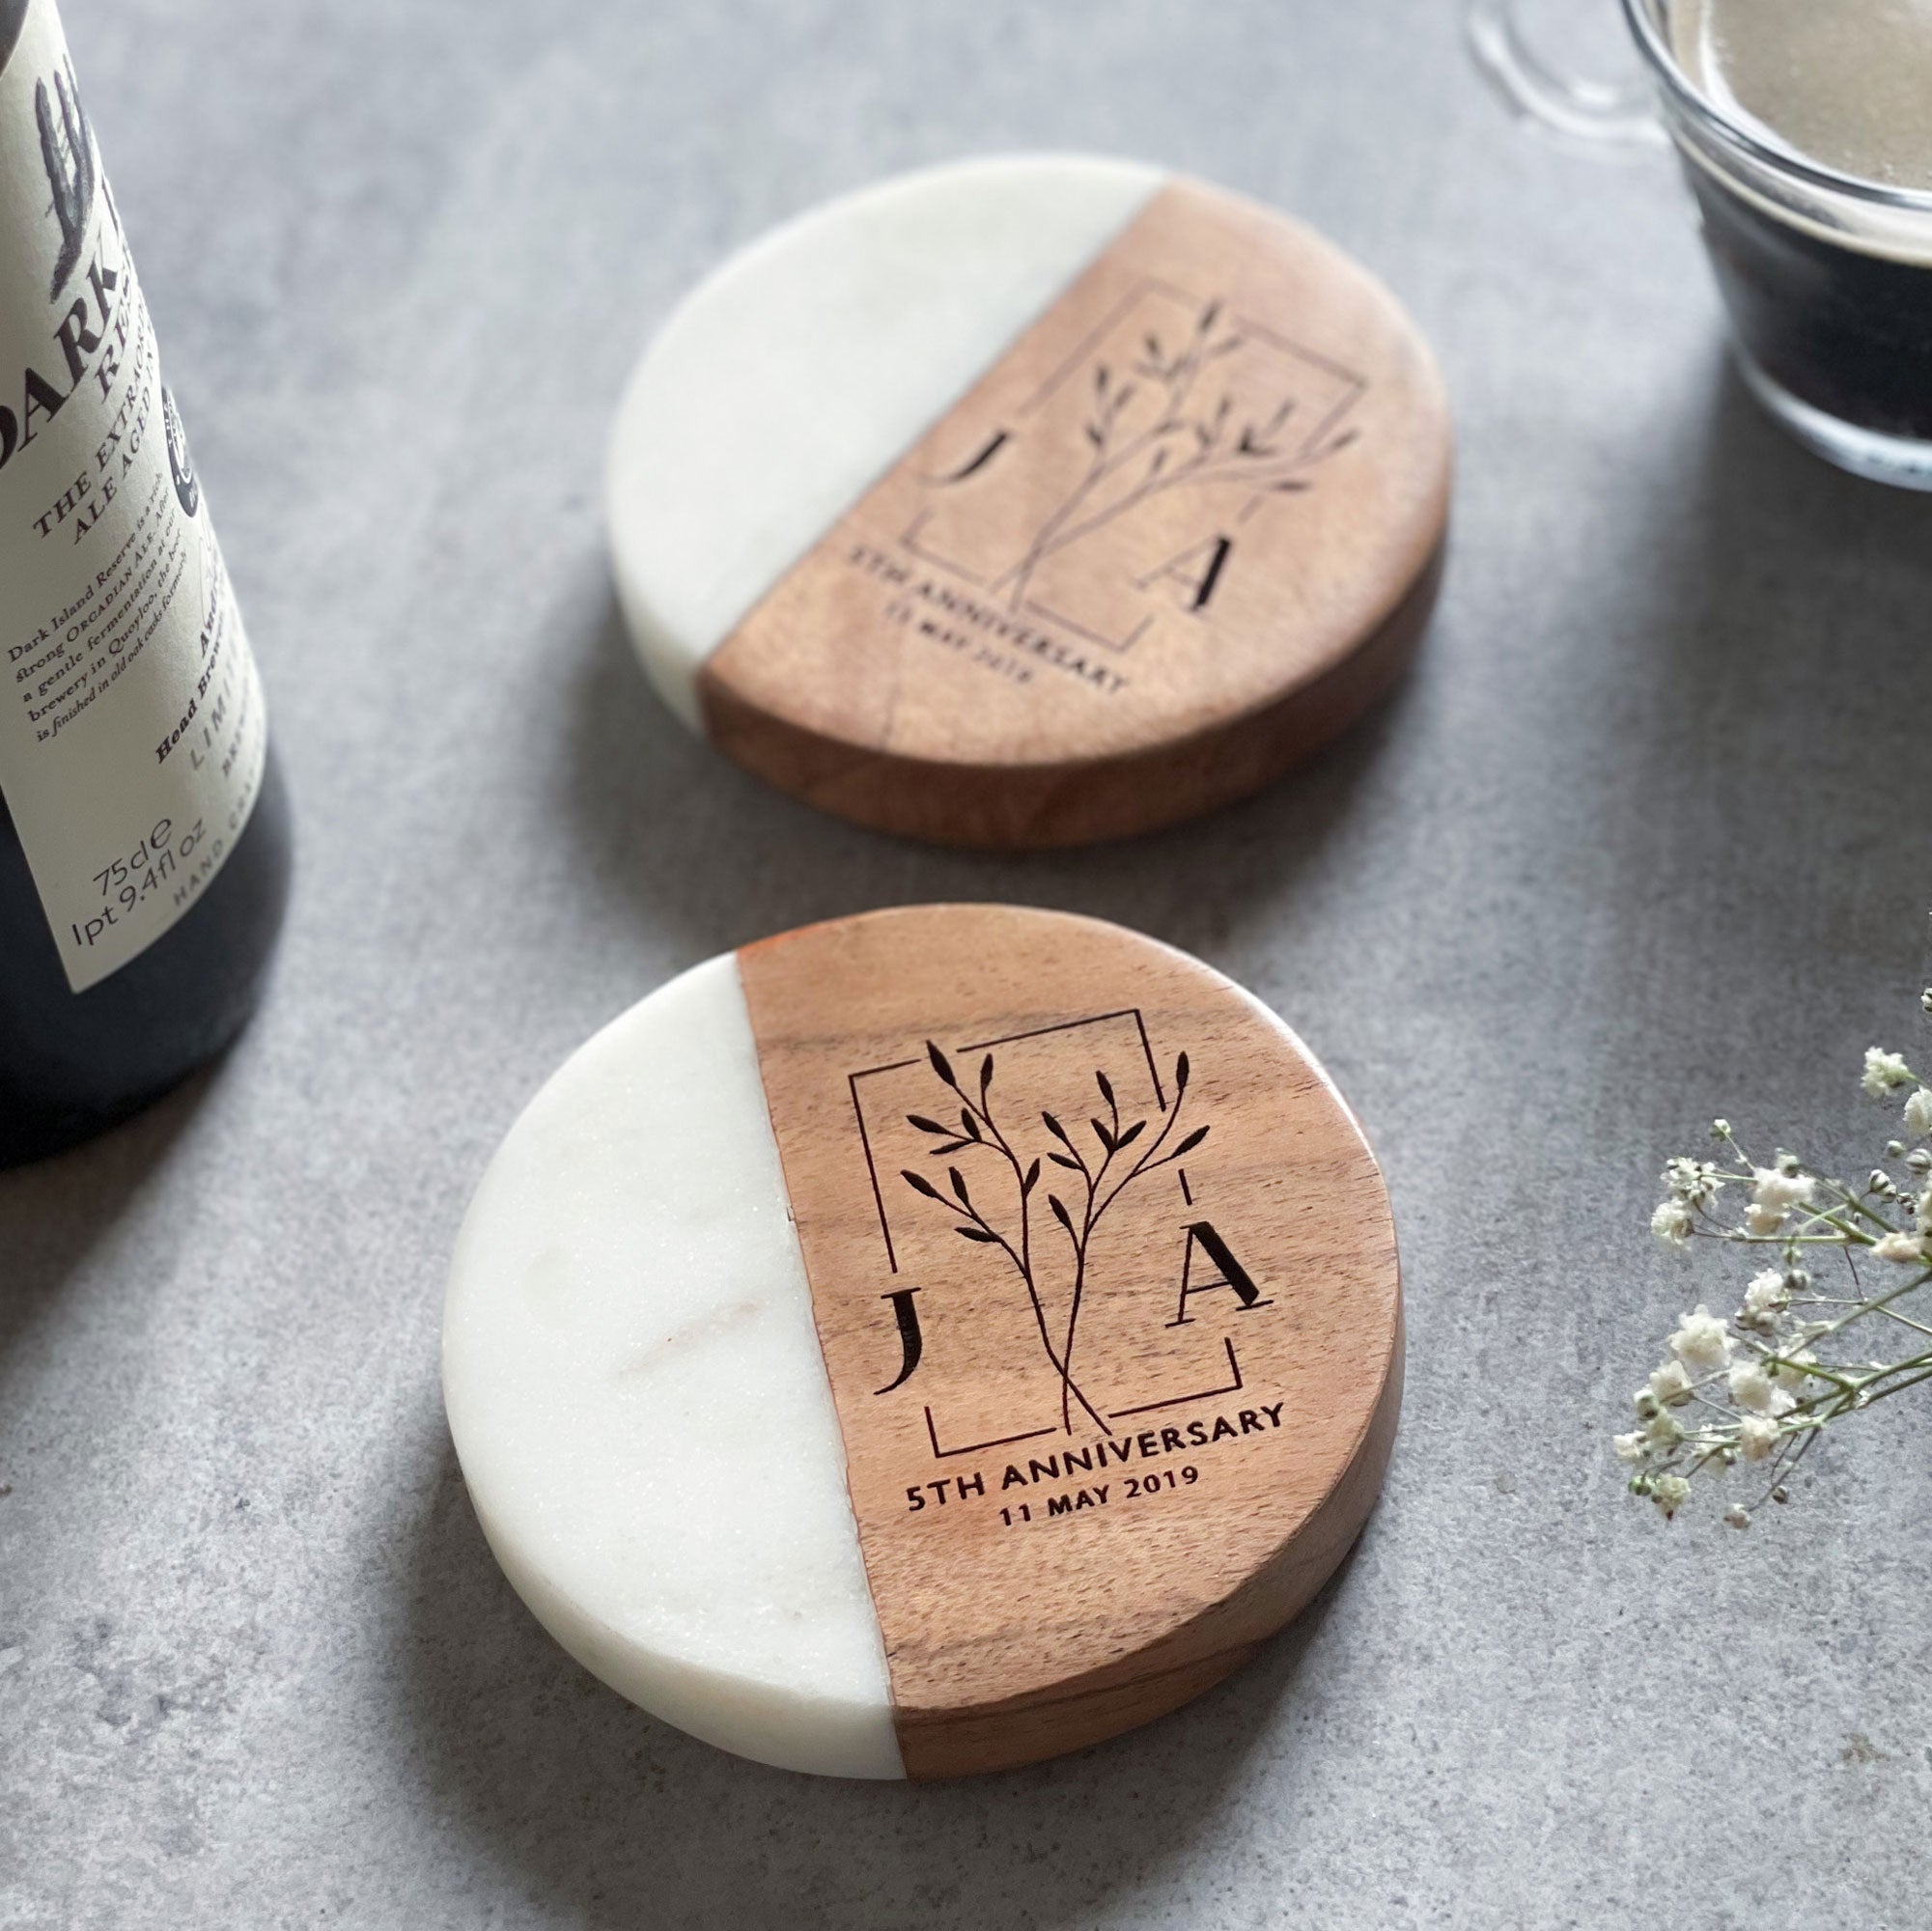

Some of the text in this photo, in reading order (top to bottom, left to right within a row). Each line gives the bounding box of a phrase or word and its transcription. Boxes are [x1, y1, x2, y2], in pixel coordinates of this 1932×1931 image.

[919, 428, 1012, 488] J
[33, 471, 92, 539] THE
[74, 476, 118, 546] ALE
[8, 629, 50, 663] Dark
[50, 584, 95, 631] Island
[96, 532, 136, 588] Reserve
[136, 516, 145, 532] is
[146, 505, 151, 517] a
[1134, 534, 1232, 614] A
[15, 642, 66, 684] strong
[23, 691, 33, 703] a
[38, 651, 84, 697] gentle
[87, 558, 157, 653] fermentation
[28, 672, 89, 722] brewery
[91, 657, 106, 675] in
[108, 592, 157, 657] Quoyloo,
[157, 563, 170, 588] the
[37, 727, 50, 742] is
[51, 686, 96, 738] finished
[98, 679, 109, 693] in
[111, 656, 126, 682] old
[127, 637, 144, 662] oak
[145, 610, 162, 641] casks
[155, 697, 198, 764] Head
[180, 818, 206, 857] oz
[1164, 1220, 1274, 1329] A
[873, 1287, 923, 1395] J
[906, 1402, 1284, 1512] 5TH ANNIVERSARY
[998, 1466, 1199, 1526] 11 MAY 2019
